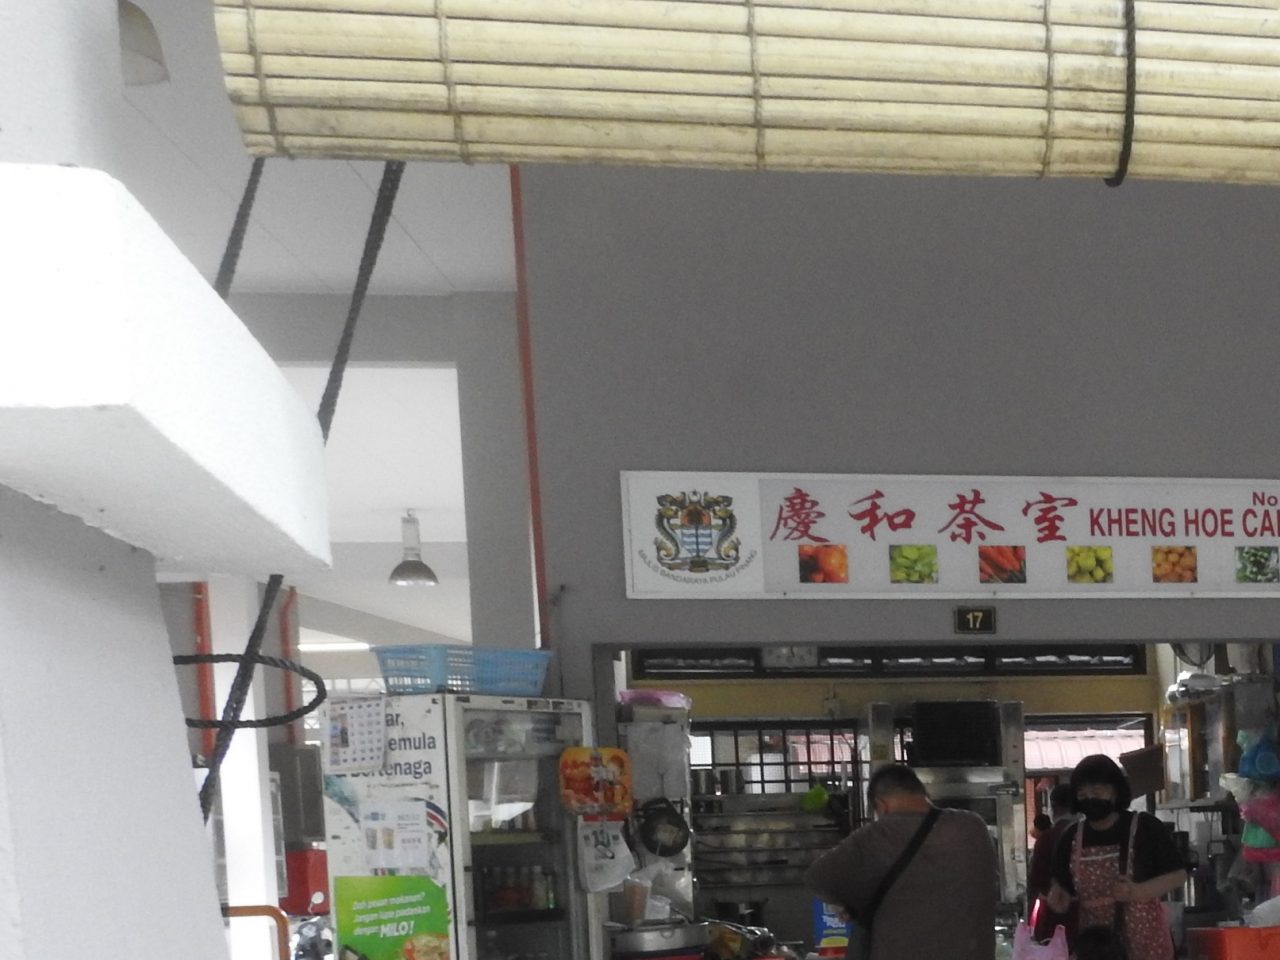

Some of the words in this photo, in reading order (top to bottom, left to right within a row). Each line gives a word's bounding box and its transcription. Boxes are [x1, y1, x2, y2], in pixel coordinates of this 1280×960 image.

[769, 487, 1078, 544] 慶和茶室
[1089, 507, 1176, 538] KHENG
[1184, 507, 1235, 538] HOE
[966, 611, 984, 629] 17
